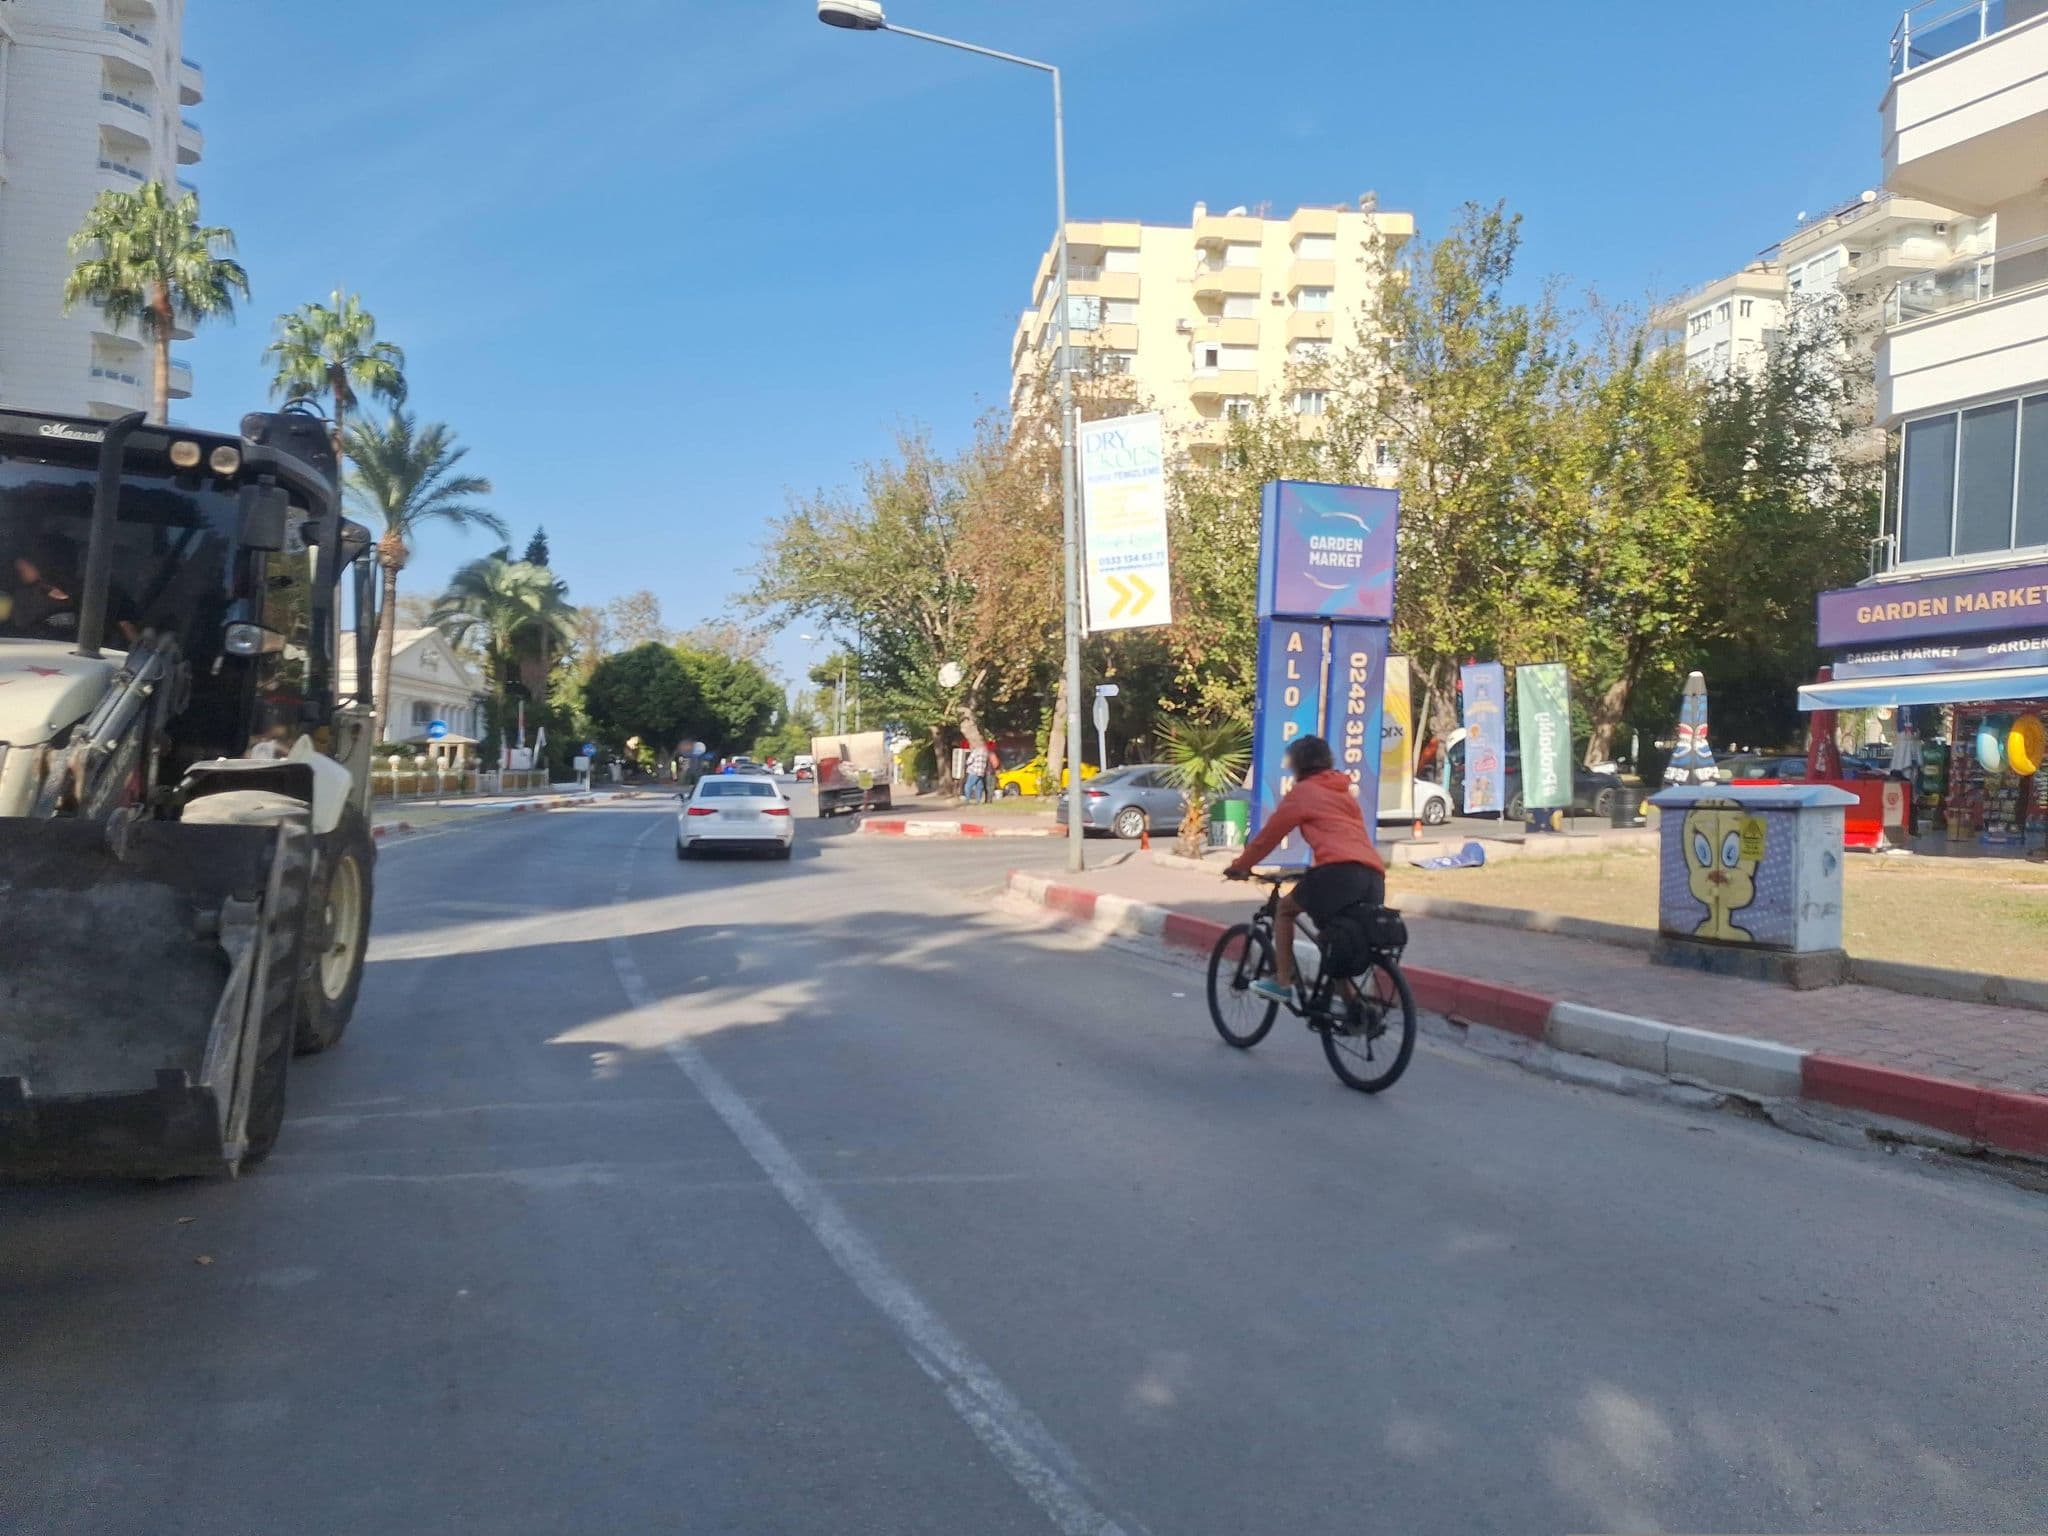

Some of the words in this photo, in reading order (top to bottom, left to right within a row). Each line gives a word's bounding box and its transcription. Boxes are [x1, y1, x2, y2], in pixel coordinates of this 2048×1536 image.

[1086, 429, 1130, 454] DRY
[1310, 535, 1363, 552] GARDEN
[1309, 551, 1362, 568] MARKET
[1856, 597, 1948, 625] GARDEN
[1847, 649, 1900, 664] GARDEN
[1901, 646, 1960, 660] MARKET
[1347, 652, 1369, 715] 0242
[1344, 720, 1365, 764] 316
